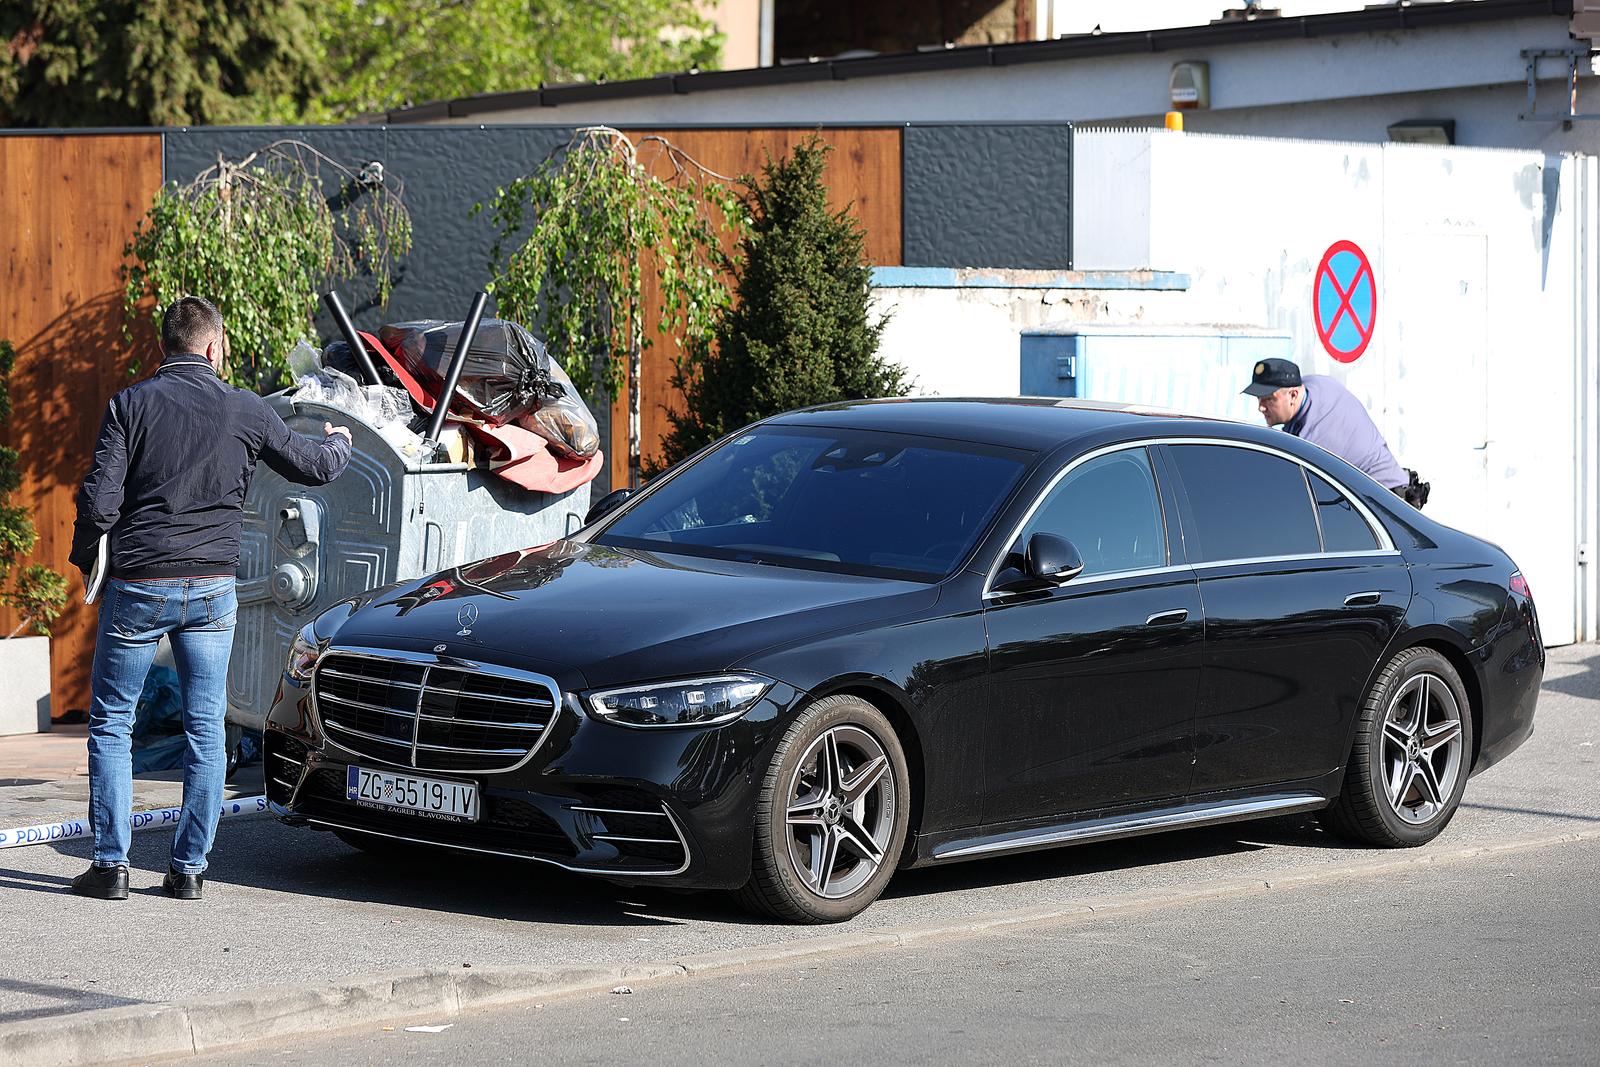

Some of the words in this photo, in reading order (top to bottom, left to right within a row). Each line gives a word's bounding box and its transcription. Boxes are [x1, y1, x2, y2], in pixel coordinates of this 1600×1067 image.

[348, 786, 358, 795] HR
[360, 771, 382, 800] ZG
[356, 800, 385, 810] PORSCHE
[387, 805, 416, 816] ZAGREB
[418, 810, 462, 823] SLAVONSKA
[15, 822, 83, 844] POLICIJA
